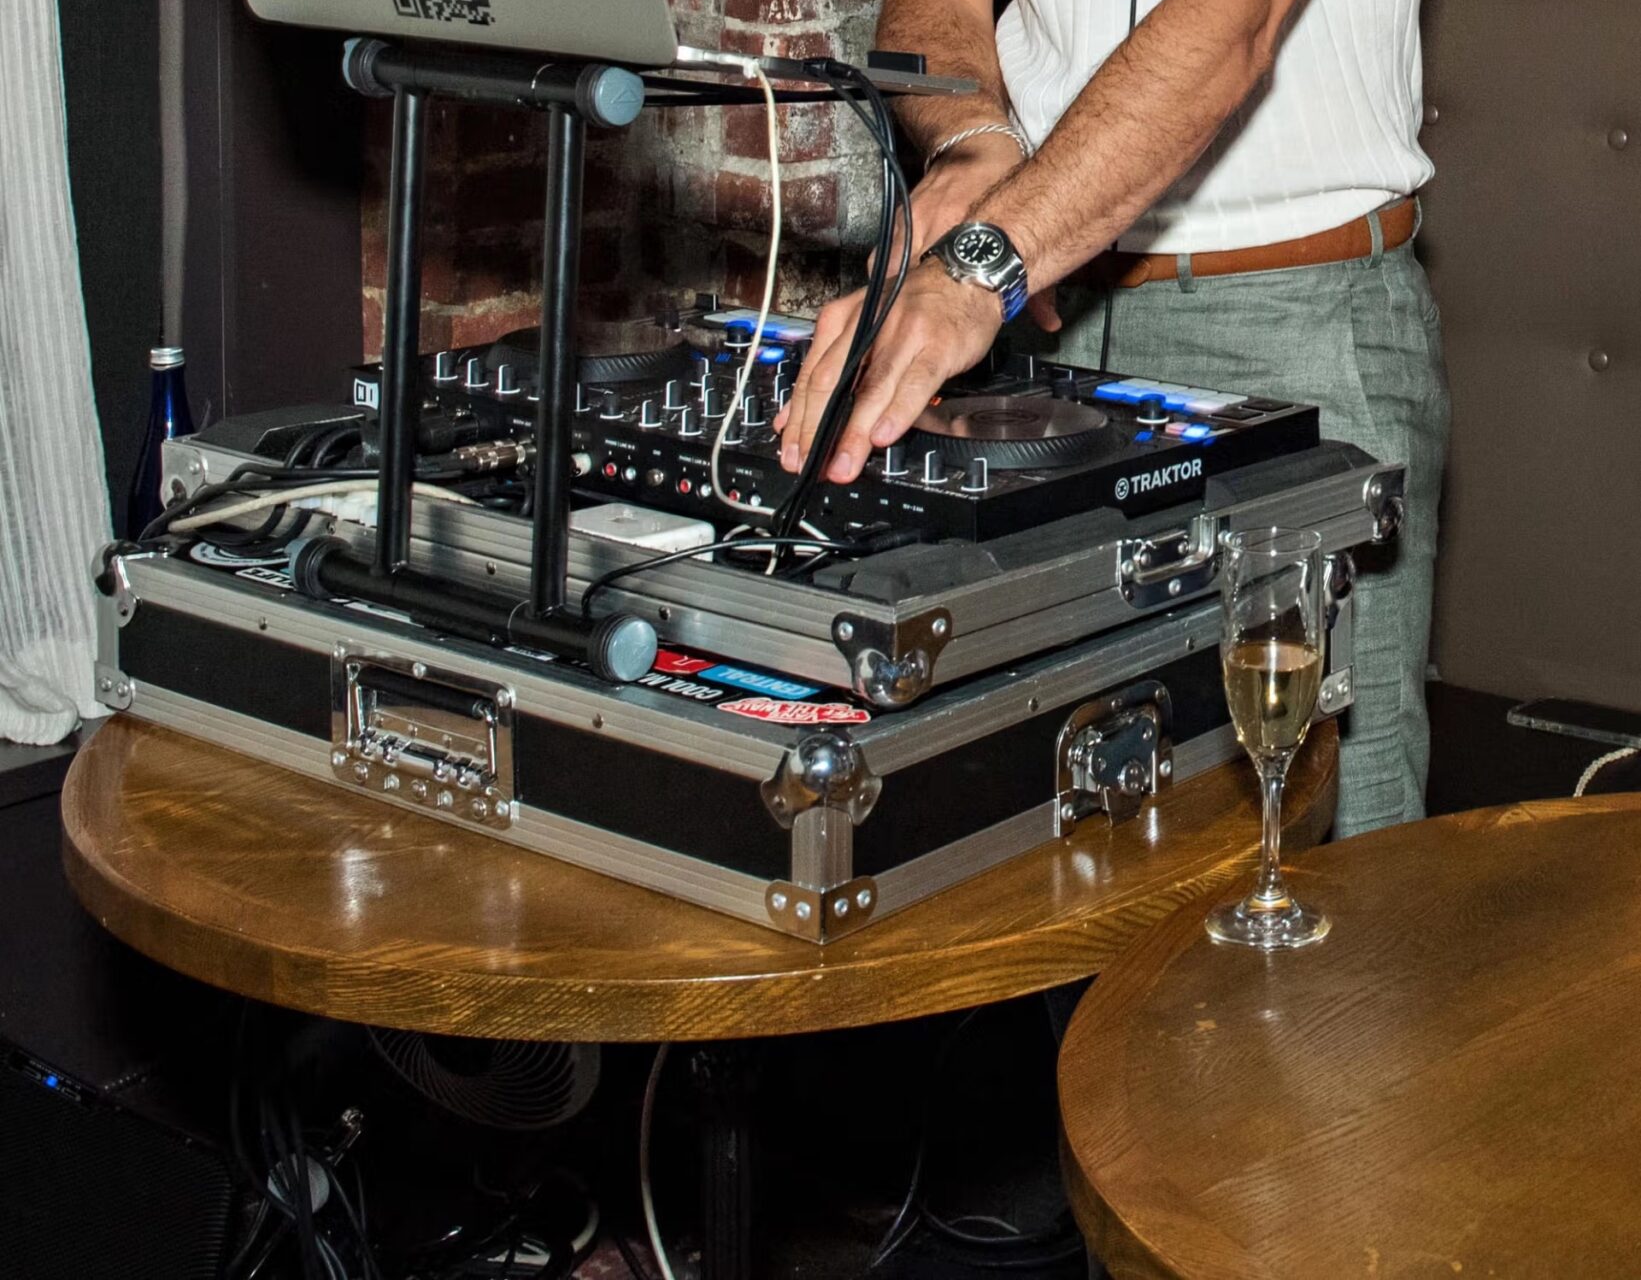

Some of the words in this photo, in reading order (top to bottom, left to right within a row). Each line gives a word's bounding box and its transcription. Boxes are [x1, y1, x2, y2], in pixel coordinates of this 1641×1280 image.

[1130, 458, 1202, 494] TRAKTOR
[662, 678, 724, 700] COOL
[717, 667, 812, 696] CENTRAL
